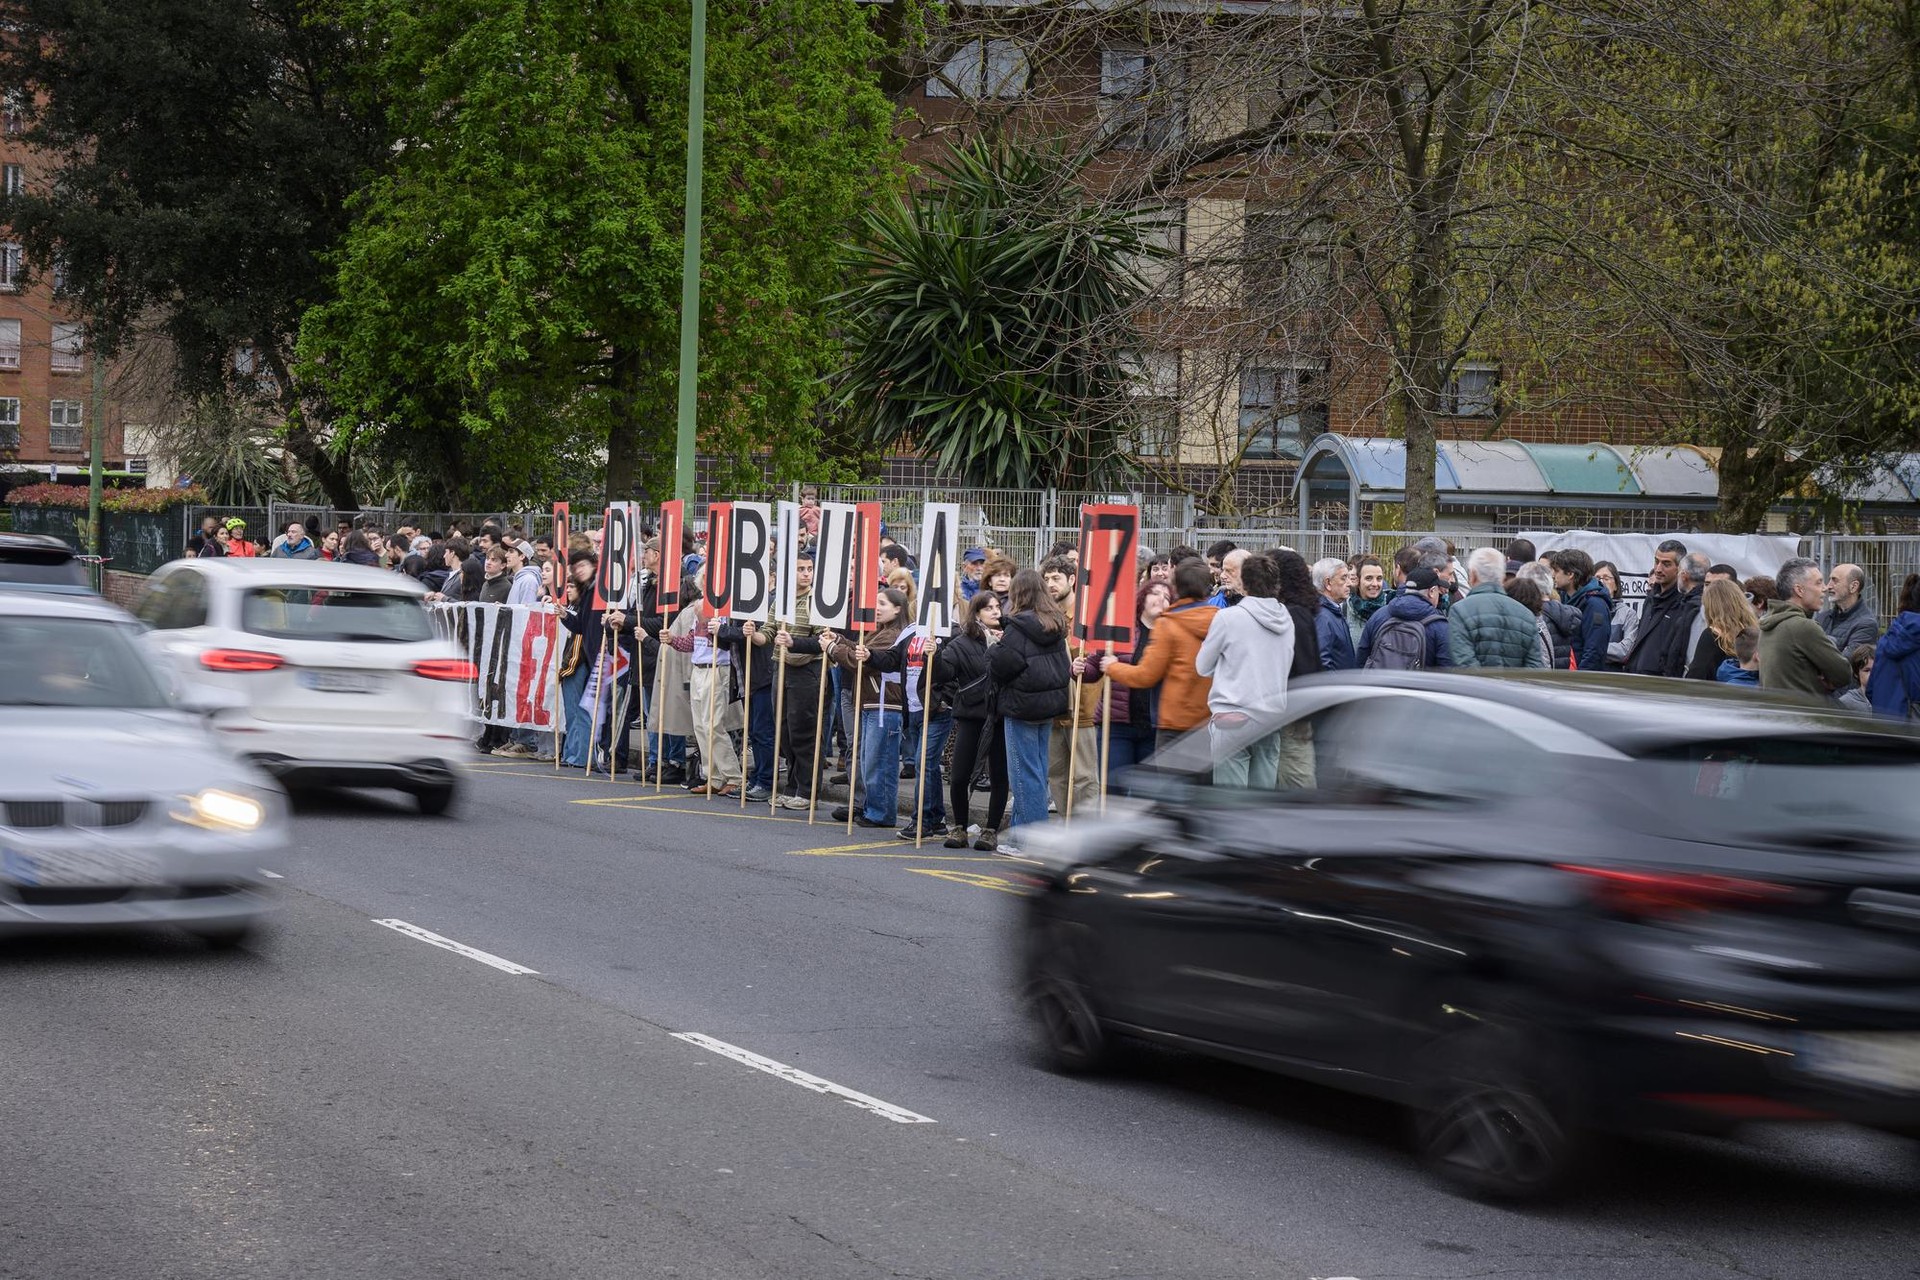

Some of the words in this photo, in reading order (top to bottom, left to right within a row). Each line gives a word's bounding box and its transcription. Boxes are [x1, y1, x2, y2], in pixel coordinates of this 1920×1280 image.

[610, 508, 627, 602] B
[658, 509, 678, 605] L
[706, 508, 735, 609] U
[732, 508, 766, 614] B
[815, 509, 854, 619] U
[854, 511, 877, 622] L
[918, 511, 949, 627] A
[1094, 514, 1134, 641] Z
